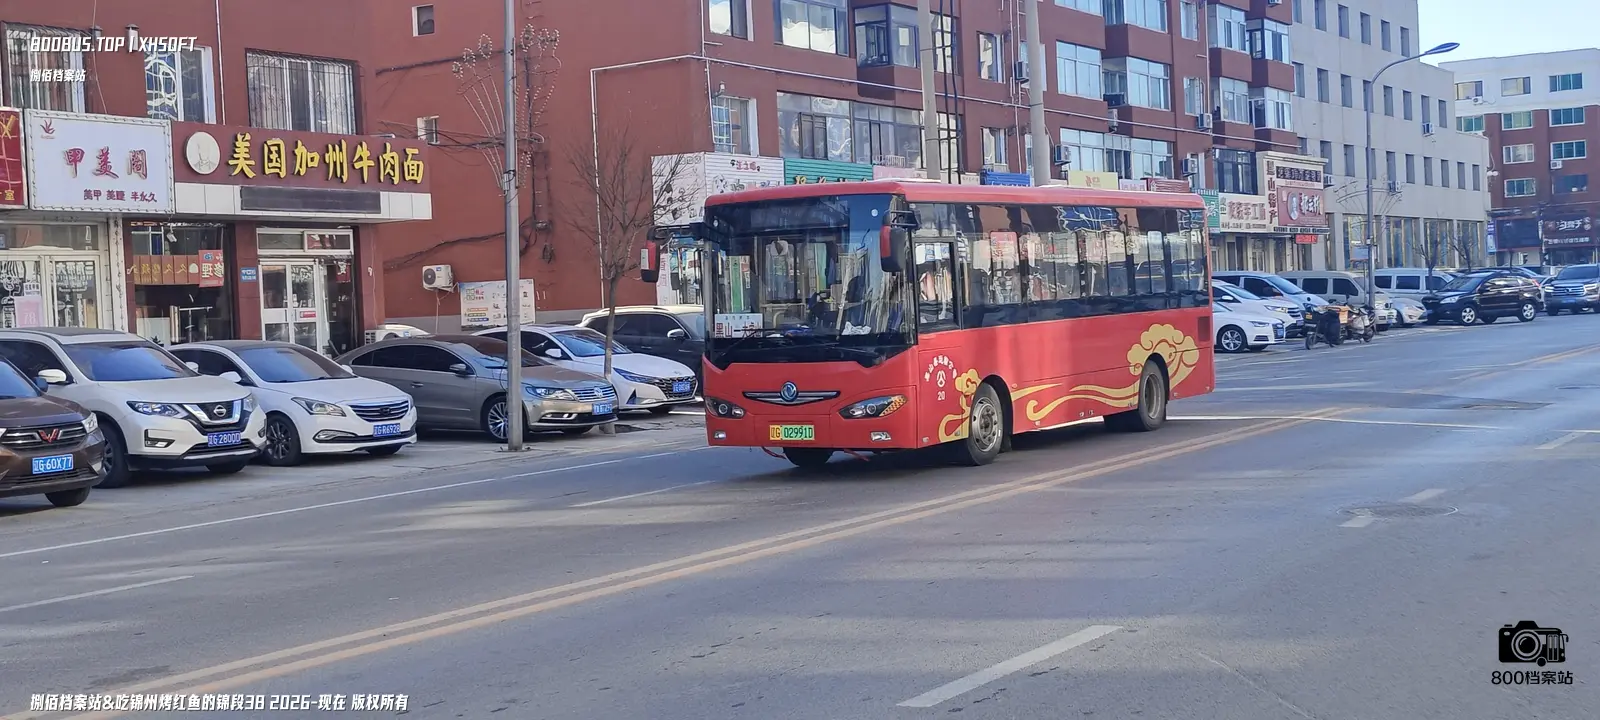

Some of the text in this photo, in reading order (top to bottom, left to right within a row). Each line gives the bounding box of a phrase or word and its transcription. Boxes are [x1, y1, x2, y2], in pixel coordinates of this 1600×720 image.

[228, 132, 424, 184] 美国加州牛肉面
[83, 189, 102, 201] 美甲
[130, 191, 157, 202] 半永久
[937, 390, 946, 401] 20
